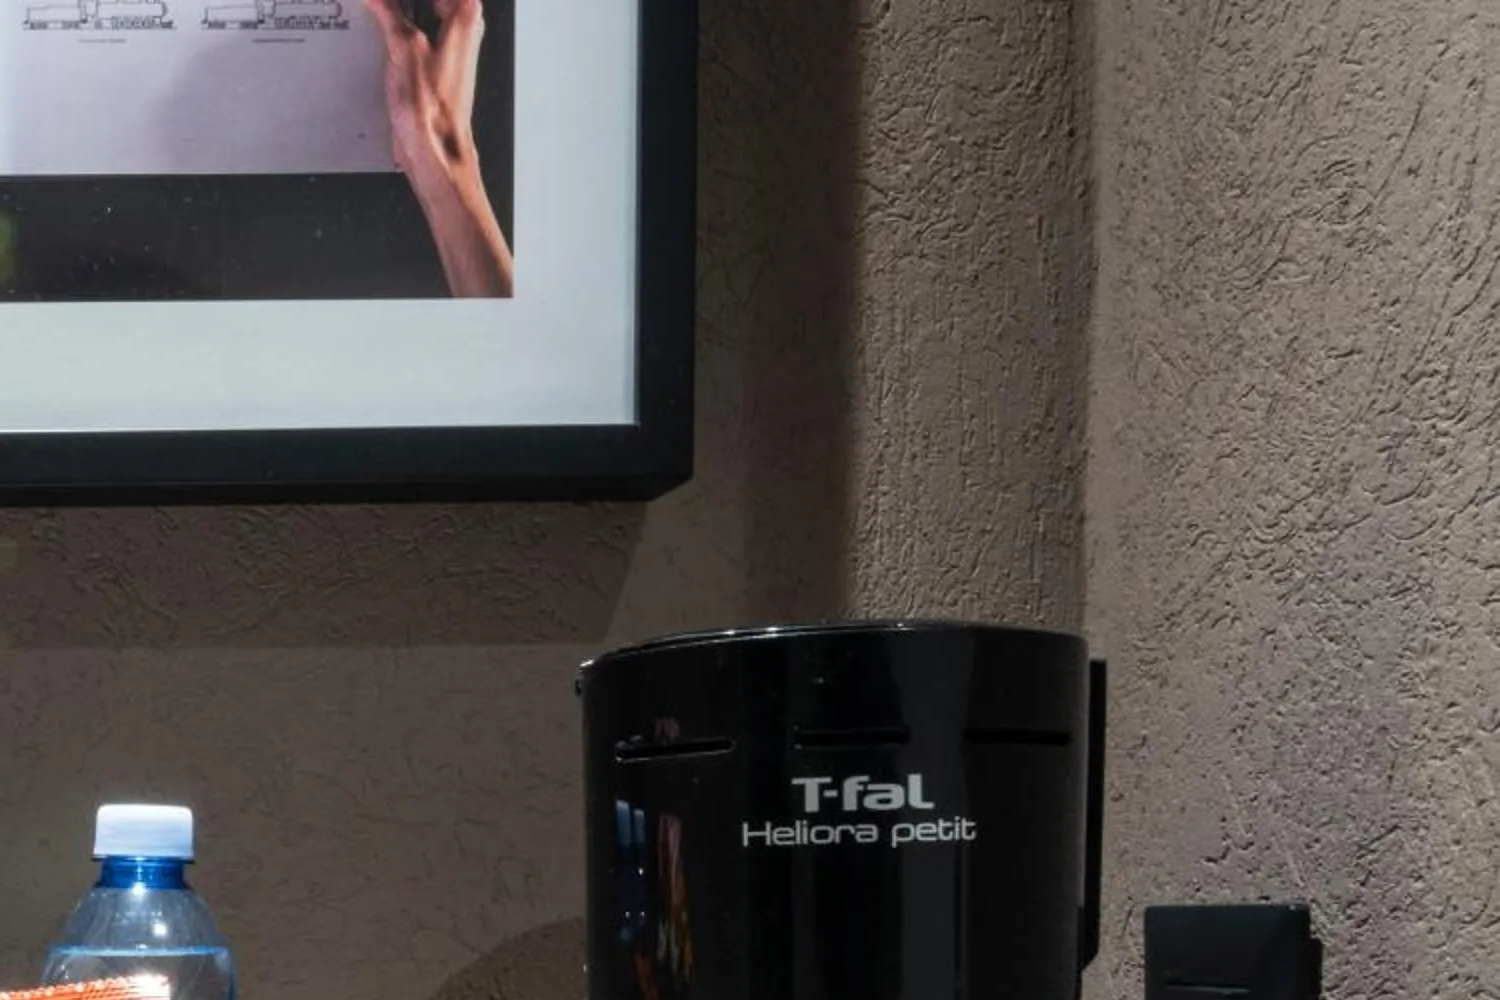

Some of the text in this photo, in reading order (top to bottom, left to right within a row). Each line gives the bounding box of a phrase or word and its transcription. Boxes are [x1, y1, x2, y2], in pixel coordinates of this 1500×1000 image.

[791, 773, 935, 813] T-fal
[742, 816, 977, 848] Heliora petit
